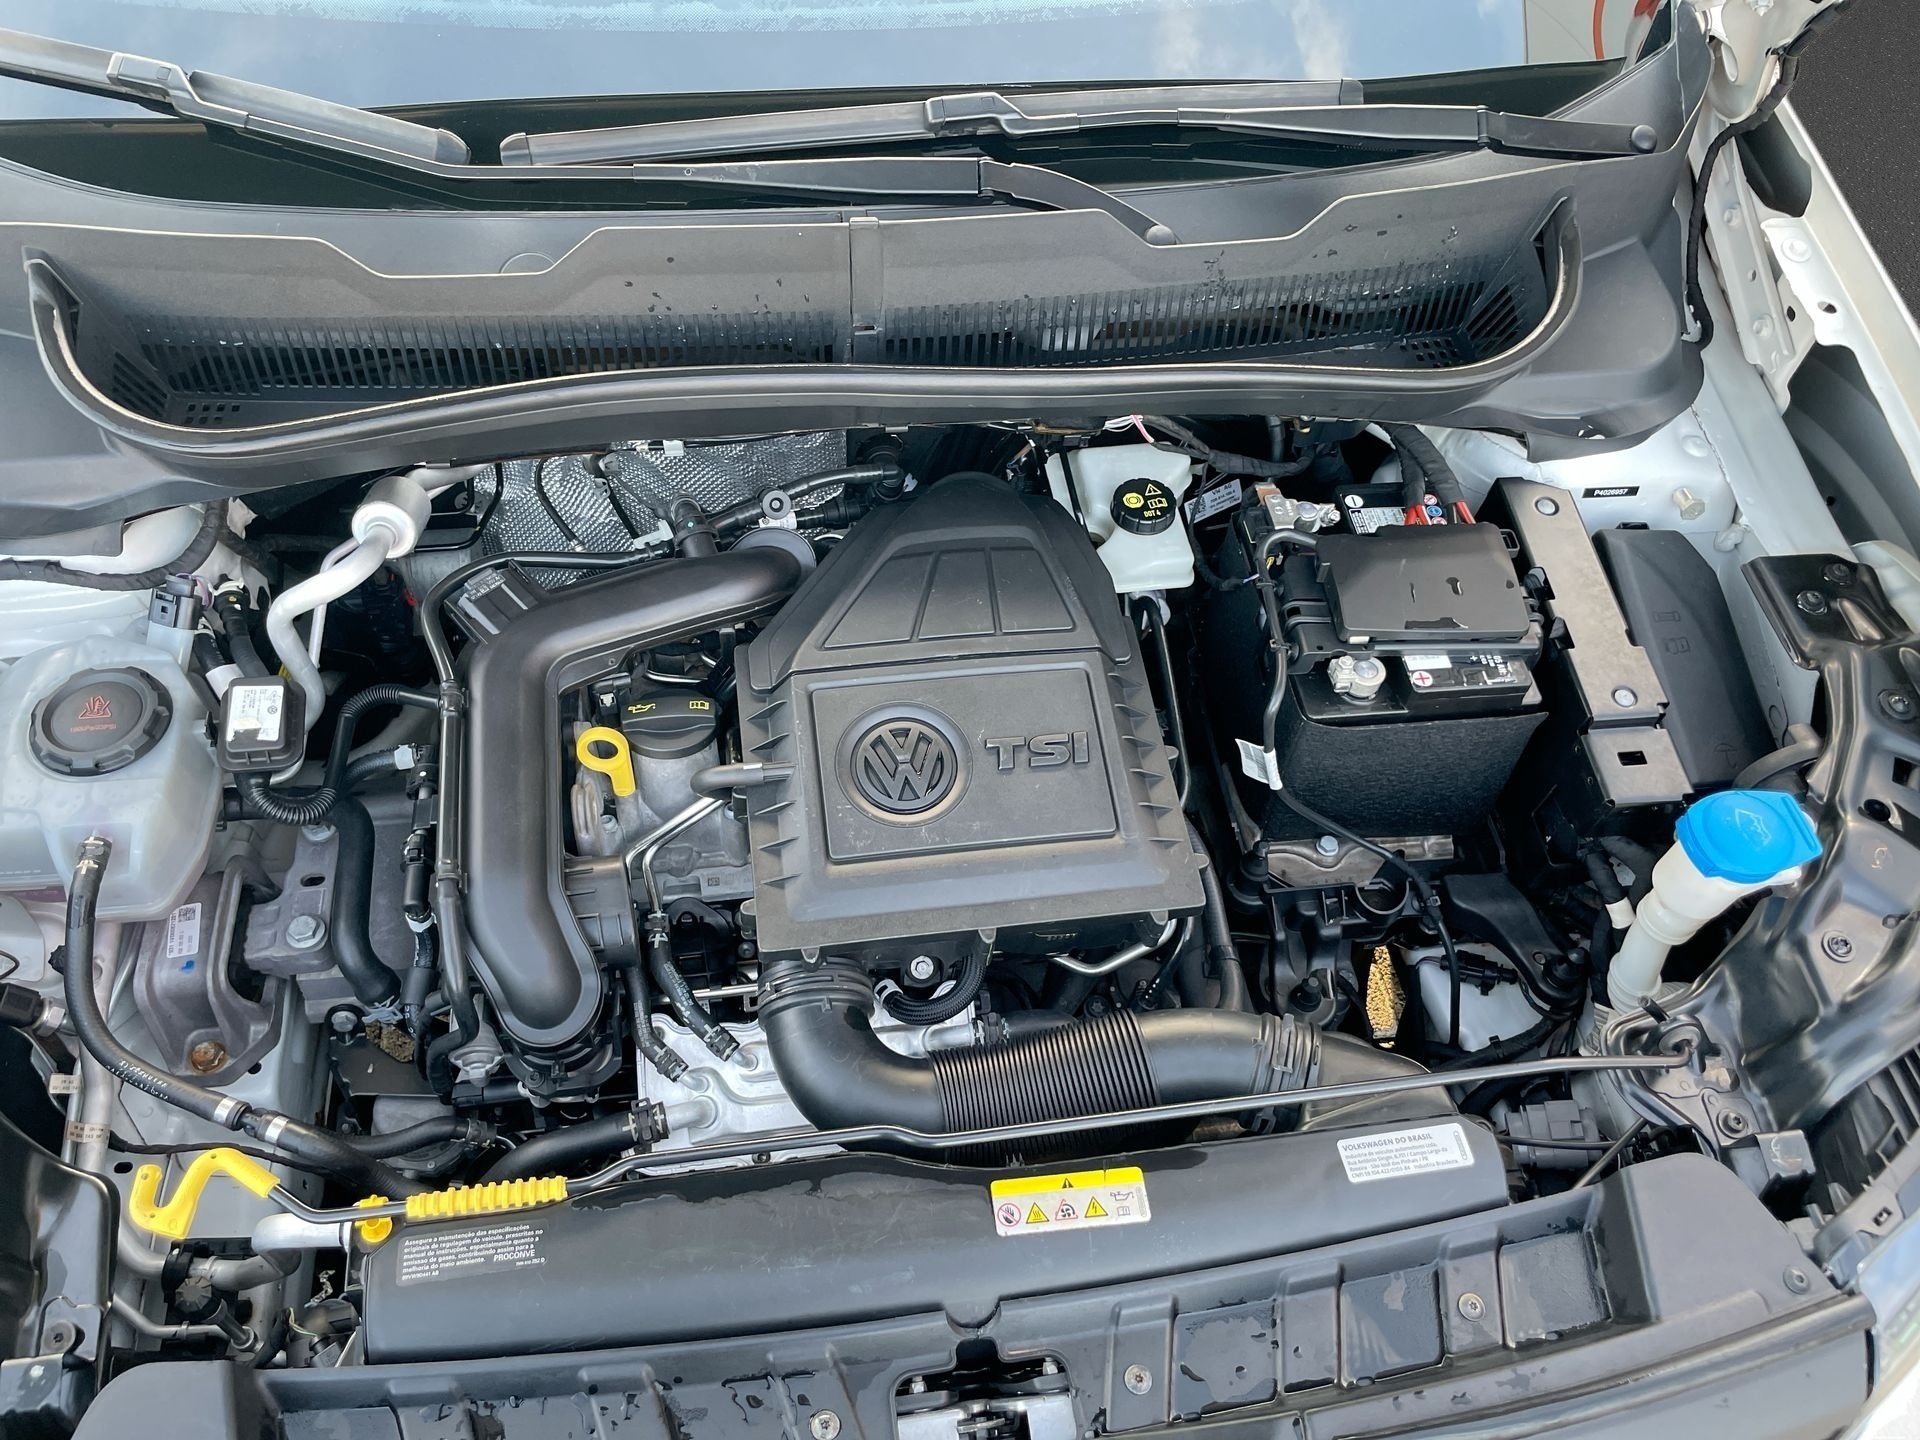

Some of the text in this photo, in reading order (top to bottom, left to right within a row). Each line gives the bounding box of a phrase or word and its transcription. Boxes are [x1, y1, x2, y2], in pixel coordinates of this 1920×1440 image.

[1143, 509, 1156, 518] DOT
[984, 730, 1090, 771] TSI
[1342, 1139, 1393, 1151] VOLKSWAGEN
[1408, 1133, 1432, 1142] BRASIL
[404, 1244, 430, 1253] originais
[440, 1240, 471, 1248] regulagem
[505, 1231, 534, 1239] prescritas
[405, 1238, 432, 1246] Assegure
[439, 1232, 475, 1241] manutenção
[488, 1225, 529, 1234] especificações
[404, 1251, 426, 1259] manual
[470, 1240, 512, 1250] especialmente
[513, 1237, 534, 1245] quanto
[458, 1249, 496, 1258] contribuindo
[494, 1250, 535, 1261] PROCONVE
